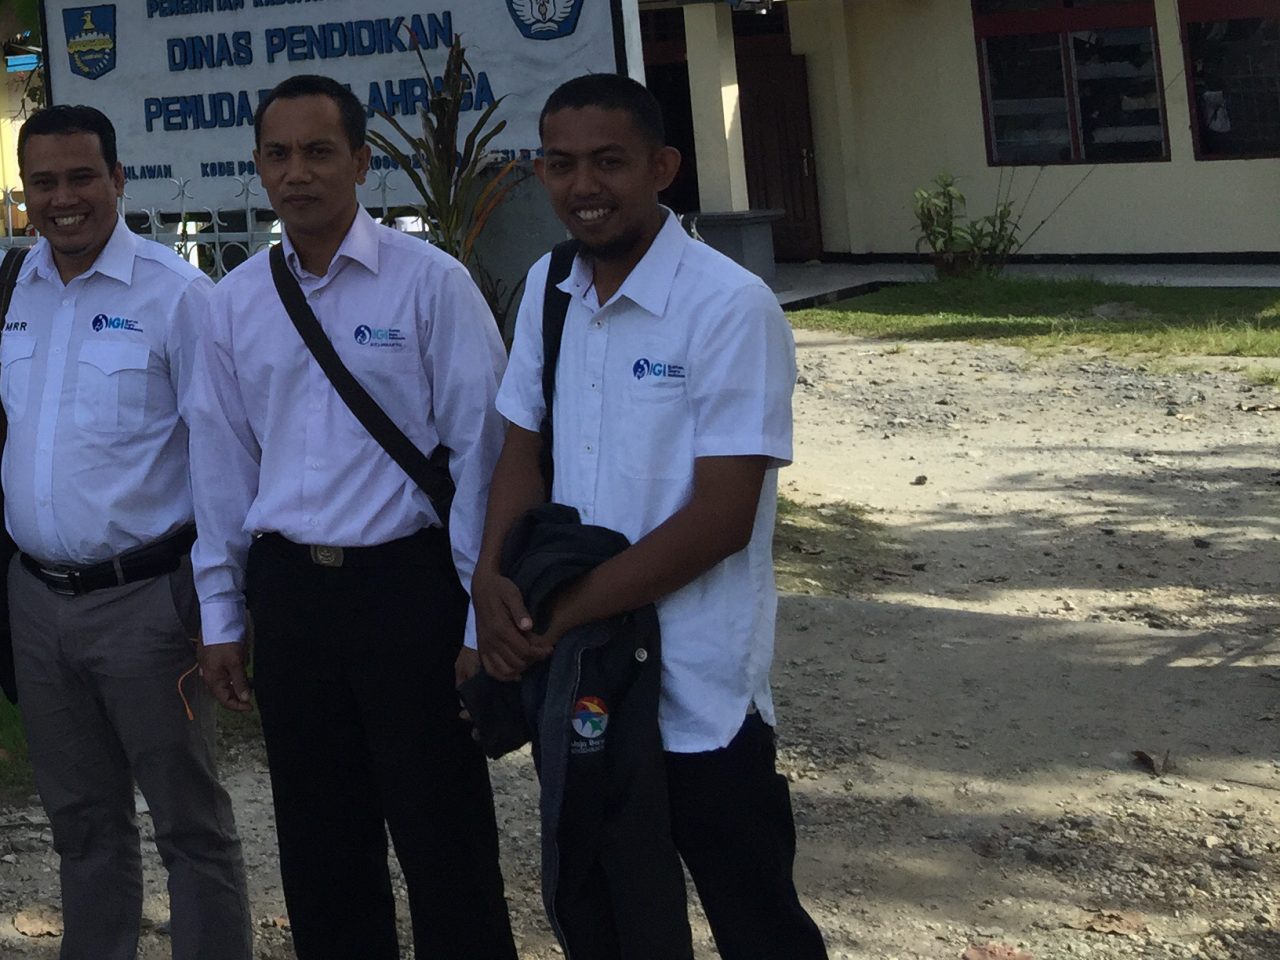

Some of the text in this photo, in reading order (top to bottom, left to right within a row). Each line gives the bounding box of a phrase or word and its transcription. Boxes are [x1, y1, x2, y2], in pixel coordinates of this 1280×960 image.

[166, 10, 454, 72] DINAS PENDIDIKAN
[143, 90, 255, 132] PEMUDA
[200, 161, 236, 178] KODE
[649, 362, 667, 377] IGI
